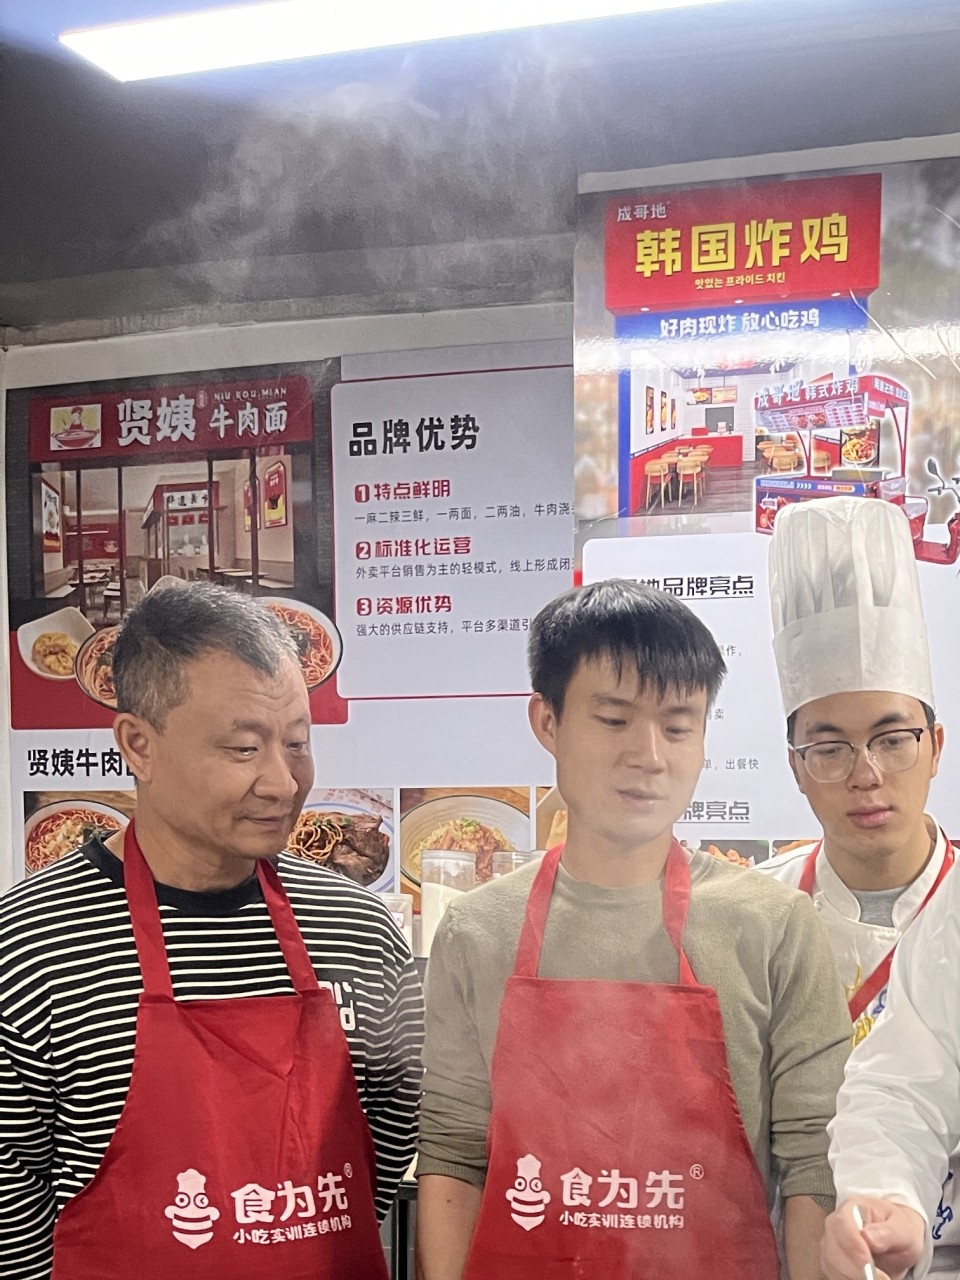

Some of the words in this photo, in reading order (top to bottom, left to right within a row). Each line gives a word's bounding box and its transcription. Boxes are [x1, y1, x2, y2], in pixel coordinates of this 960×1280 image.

[616, 202, 668, 222] 成哥地
[635, 212, 849, 278] 韩国炸鸡
[660, 314, 737, 339] 好肉现炸
[741, 308, 820, 333] 放心吃鸡
[117, 393, 196, 447] 贤姨
[209, 401, 288, 439] 牛肉面
[349, 414, 480, 456] 品牌优势
[373, 480, 450, 500] 特点鲜明
[354, 502, 574, 524] 一麻二辣三鲜，一两面，二两油，牛肉浇
[375, 537, 471, 558] 标准化运营
[356, 557, 574, 579] 外卖平台销售为主的轻模式，线上形成闭
[376, 595, 452, 615] 资源优势
[27, 749, 135, 776] 贤姨牛肉
[230, 1172, 349, 1224] 食为先
[560, 1167, 685, 1210] 食为先
[233, 1215, 352, 1245] 小吃实训连锁机构
[559, 1210, 684, 1229] 小吃实训连锁机构
